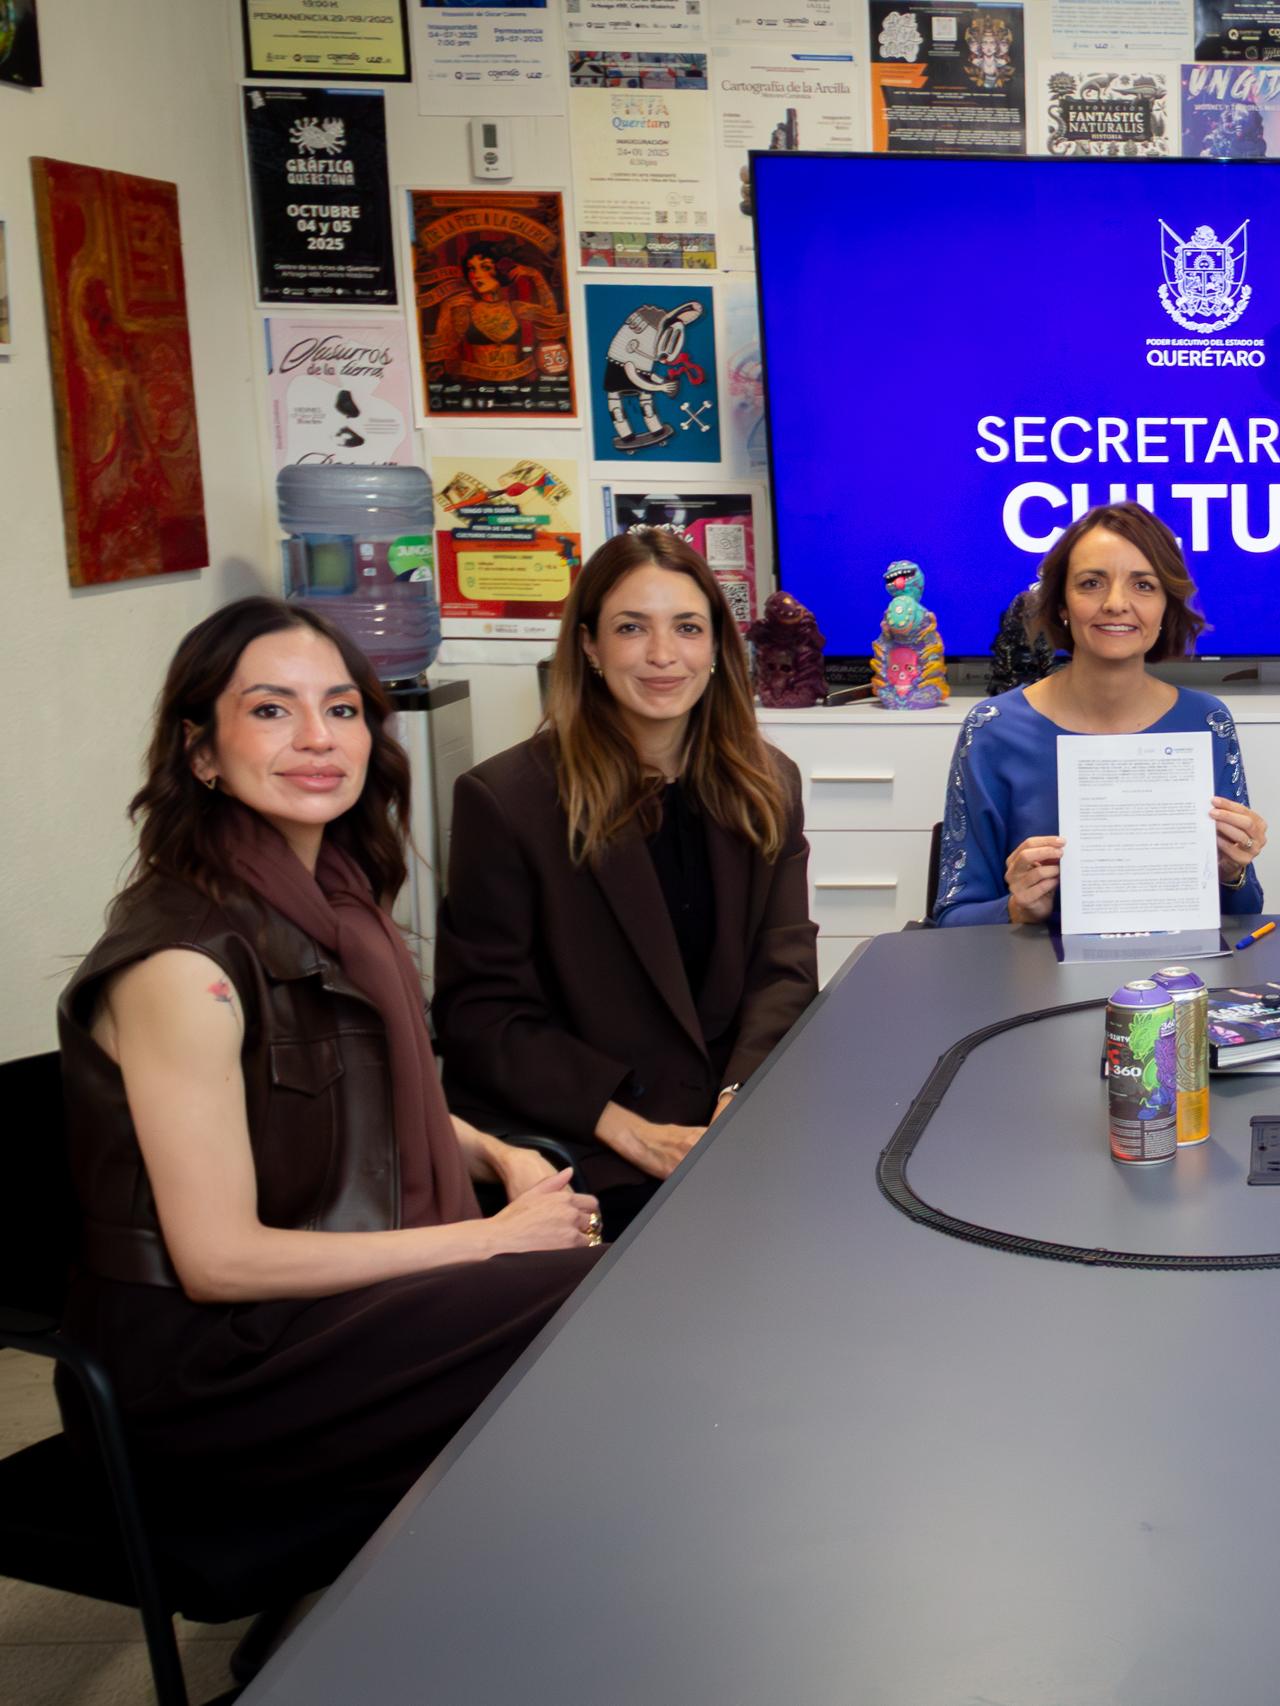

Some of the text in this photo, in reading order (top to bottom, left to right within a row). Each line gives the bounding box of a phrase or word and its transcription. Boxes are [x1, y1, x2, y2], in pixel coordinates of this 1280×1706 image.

[721, 80, 850, 94] Cartografía de la Arcilla
[611, 115, 670, 130] Querétaro
[1069, 111, 1144, 123] FANTASTIC
[1069, 122, 1144, 133] NATURALIS
[286, 158, 354, 173] GRÁFICA
[286, 205, 361, 218] OCTUBRE
[297, 219, 352, 235] 04 y 05
[307, 237, 345, 250] 2025
[1146, 338, 1171, 346] PODER
[1146, 347, 1266, 367] QUERÉTARO
[1113, 1065, 1142, 1077] 360
